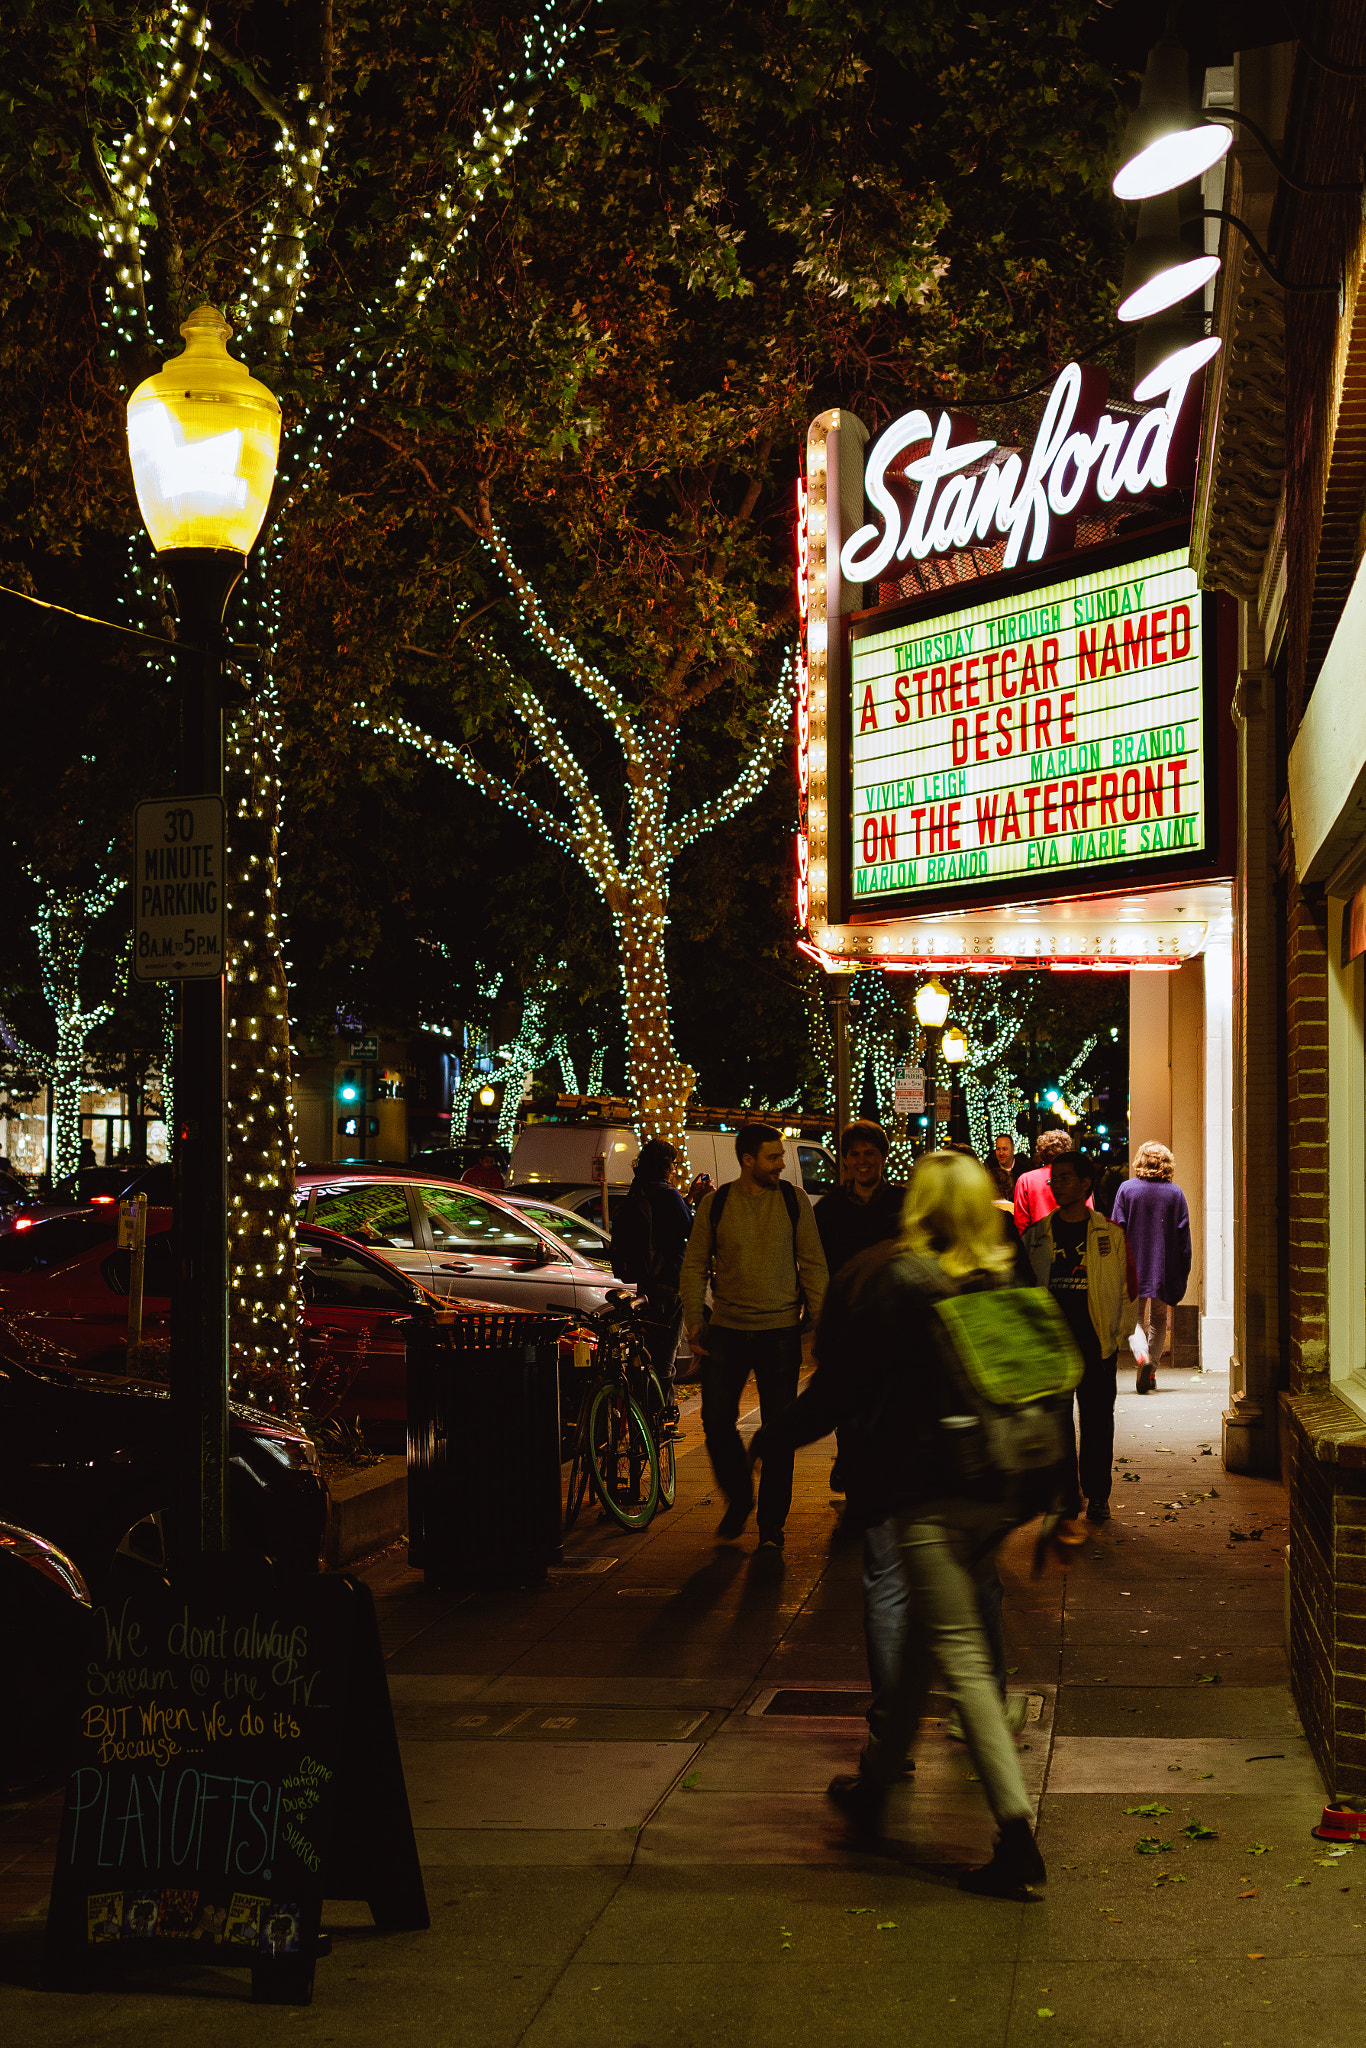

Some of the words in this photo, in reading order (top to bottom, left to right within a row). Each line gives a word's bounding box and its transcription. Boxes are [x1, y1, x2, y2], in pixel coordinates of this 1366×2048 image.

[840, 362, 1191, 583] Stanford
[895, 627, 974, 671] THURSDAY
[987, 605, 1061, 649] THROUGH
[1074, 582, 1145, 625] SUNDAY
[860, 685, 878, 731] A
[895, 638, 1059, 723] STREETCAR
[1079, 604, 1191, 681] NAMED
[953, 692, 1076, 766] DESIRE
[1031, 743, 1100, 781] MARLON
[1113, 726, 1185, 766] BRANDO
[864, 813, 896, 863] ON
[911, 801, 961, 855] THE
[976, 759, 1187, 845] WATERFRONT
[866, 780, 915, 812] VIVIEN
[924, 769, 966, 802] LEIGH
[164, 809, 194, 843] 30
[1027, 839, 1059, 868] EVA
[1071, 828, 1127, 862] MARIE
[1140, 816, 1196, 851] SAINT
[145, 845, 213, 881] MINUTE
[857, 861, 917, 893] MARLON
[927, 850, 988, 882] BRANDO
[141, 881, 217, 917] PARKING
[93, 1596, 147, 1661] We
[168, 1605, 228, 1659] don't
[234, 1612, 307, 1686] always
[190, 1663, 210, 1696] @
[222, 1668, 265, 1701] the
[81, 1705, 133, 1738] BUT
[202, 1701, 233, 1742] We
[240, 1705, 264, 1736] do
[273, 1712, 301, 1739] it's
[68, 1767, 281, 1881] PLAYOFFS!
